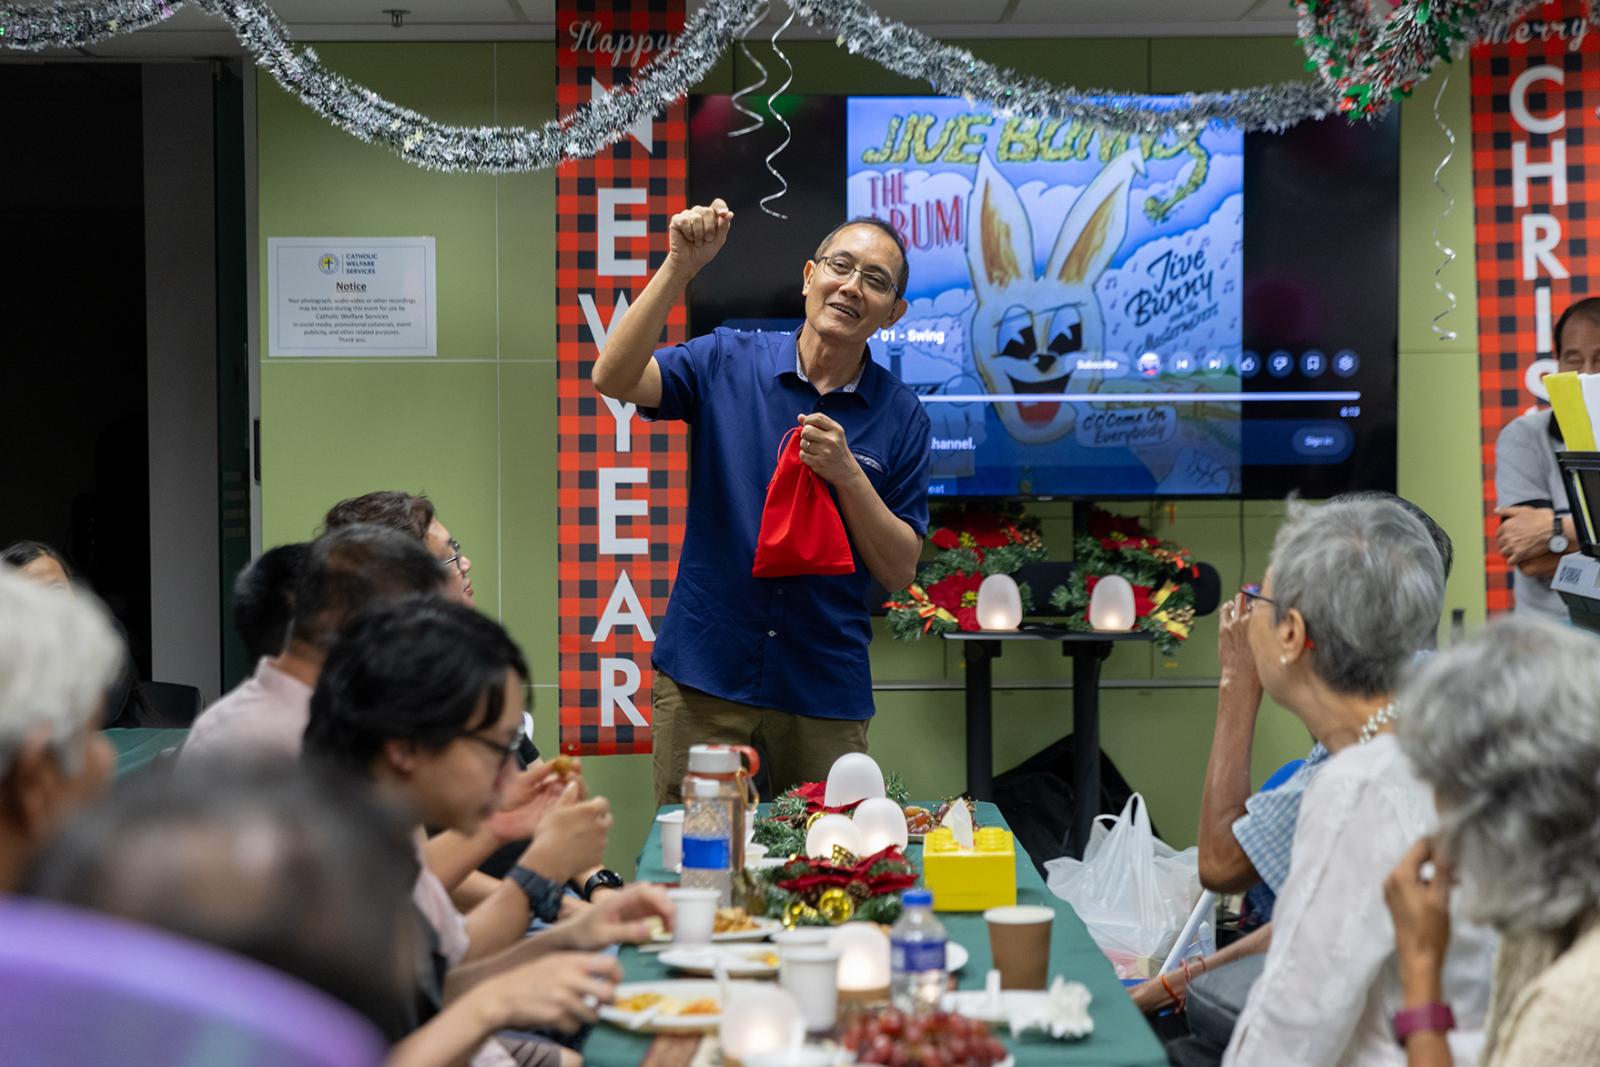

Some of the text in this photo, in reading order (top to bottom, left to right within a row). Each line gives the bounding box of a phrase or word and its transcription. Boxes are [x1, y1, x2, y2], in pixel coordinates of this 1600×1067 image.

[862, 112, 995, 164] JIVE
[868, 171, 910, 208] THE
[872, 194, 965, 252] BUM
[336, 282, 367, 292] Notice
[1147, 249, 1206, 293] Jive
[1125, 269, 1214, 328] Bunny
[881, 329, 896, 342] 01
[907, 328, 945, 345] Swing
[930, 436, 977, 451] hannel.
